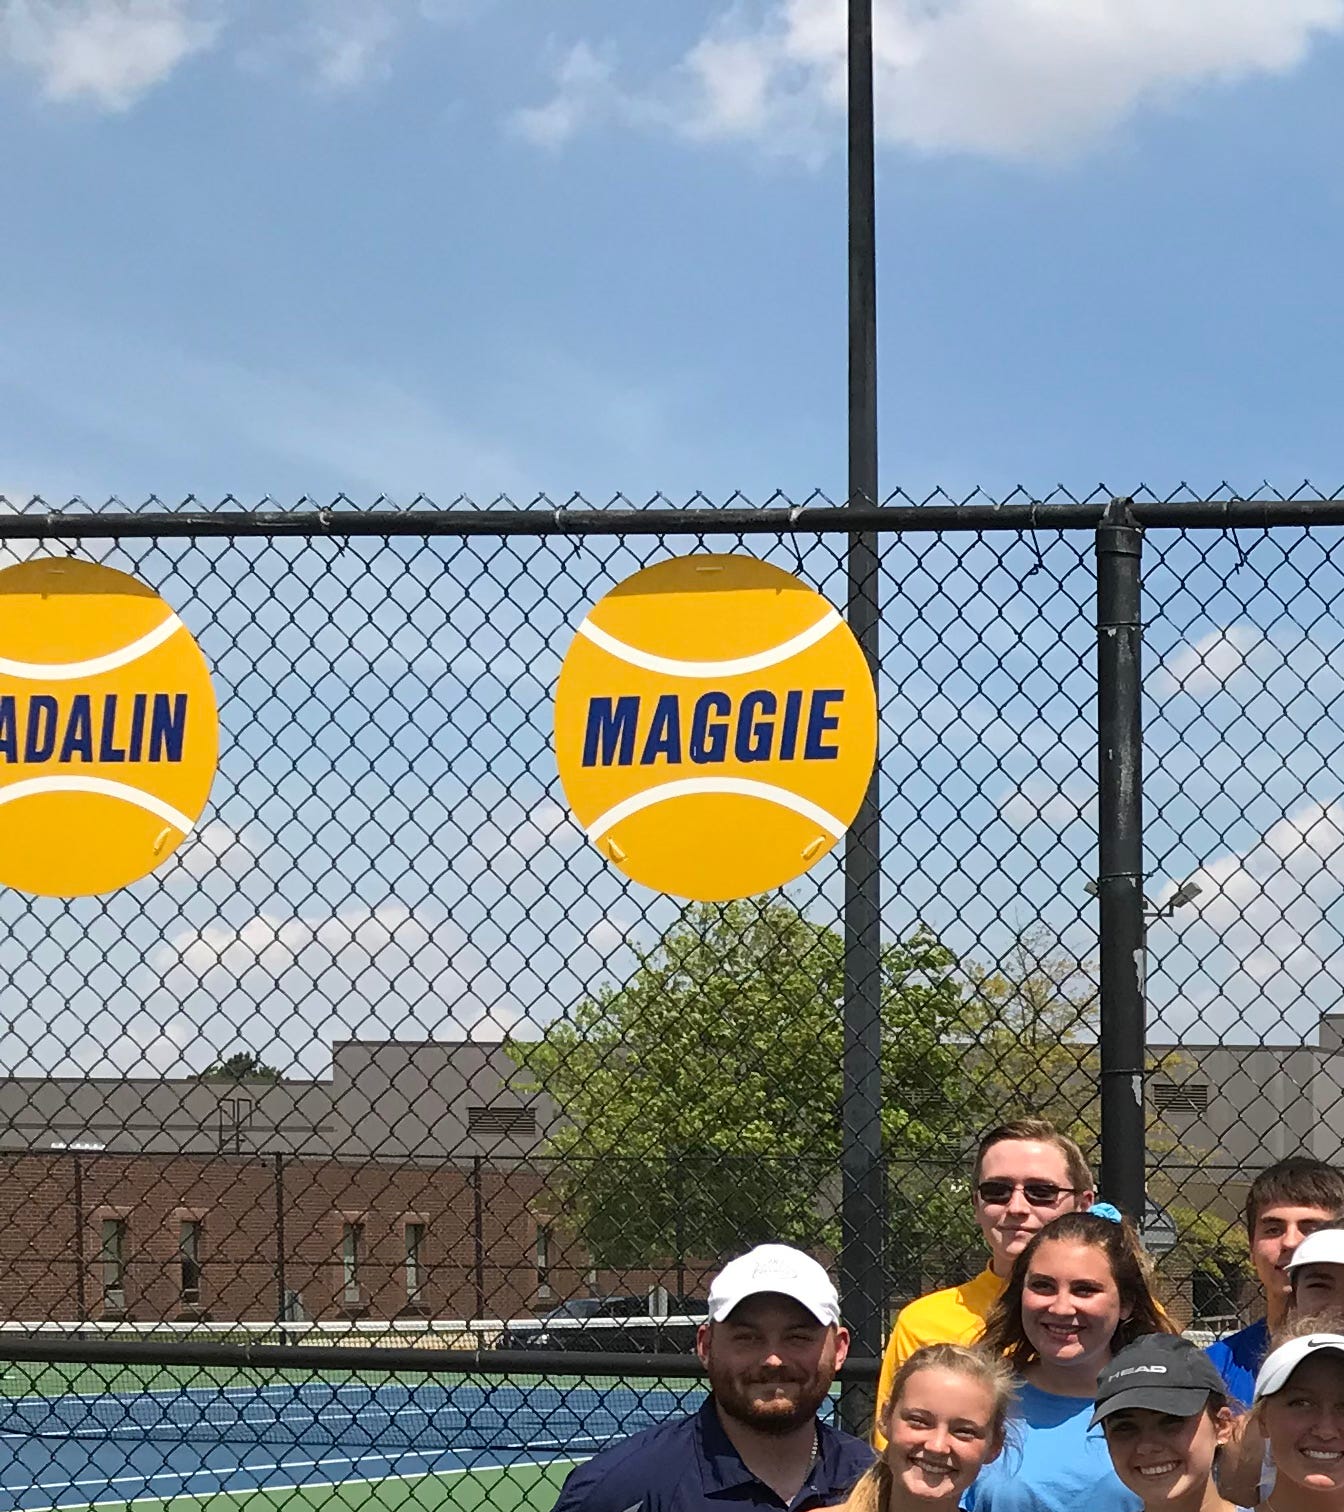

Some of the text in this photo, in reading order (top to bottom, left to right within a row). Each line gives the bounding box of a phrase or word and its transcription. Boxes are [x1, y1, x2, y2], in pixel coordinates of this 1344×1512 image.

[0, 693, 188, 763] ADALIN
[582, 689, 845, 767] MAGGIE
[1107, 1365, 1168, 1383] HEAD
